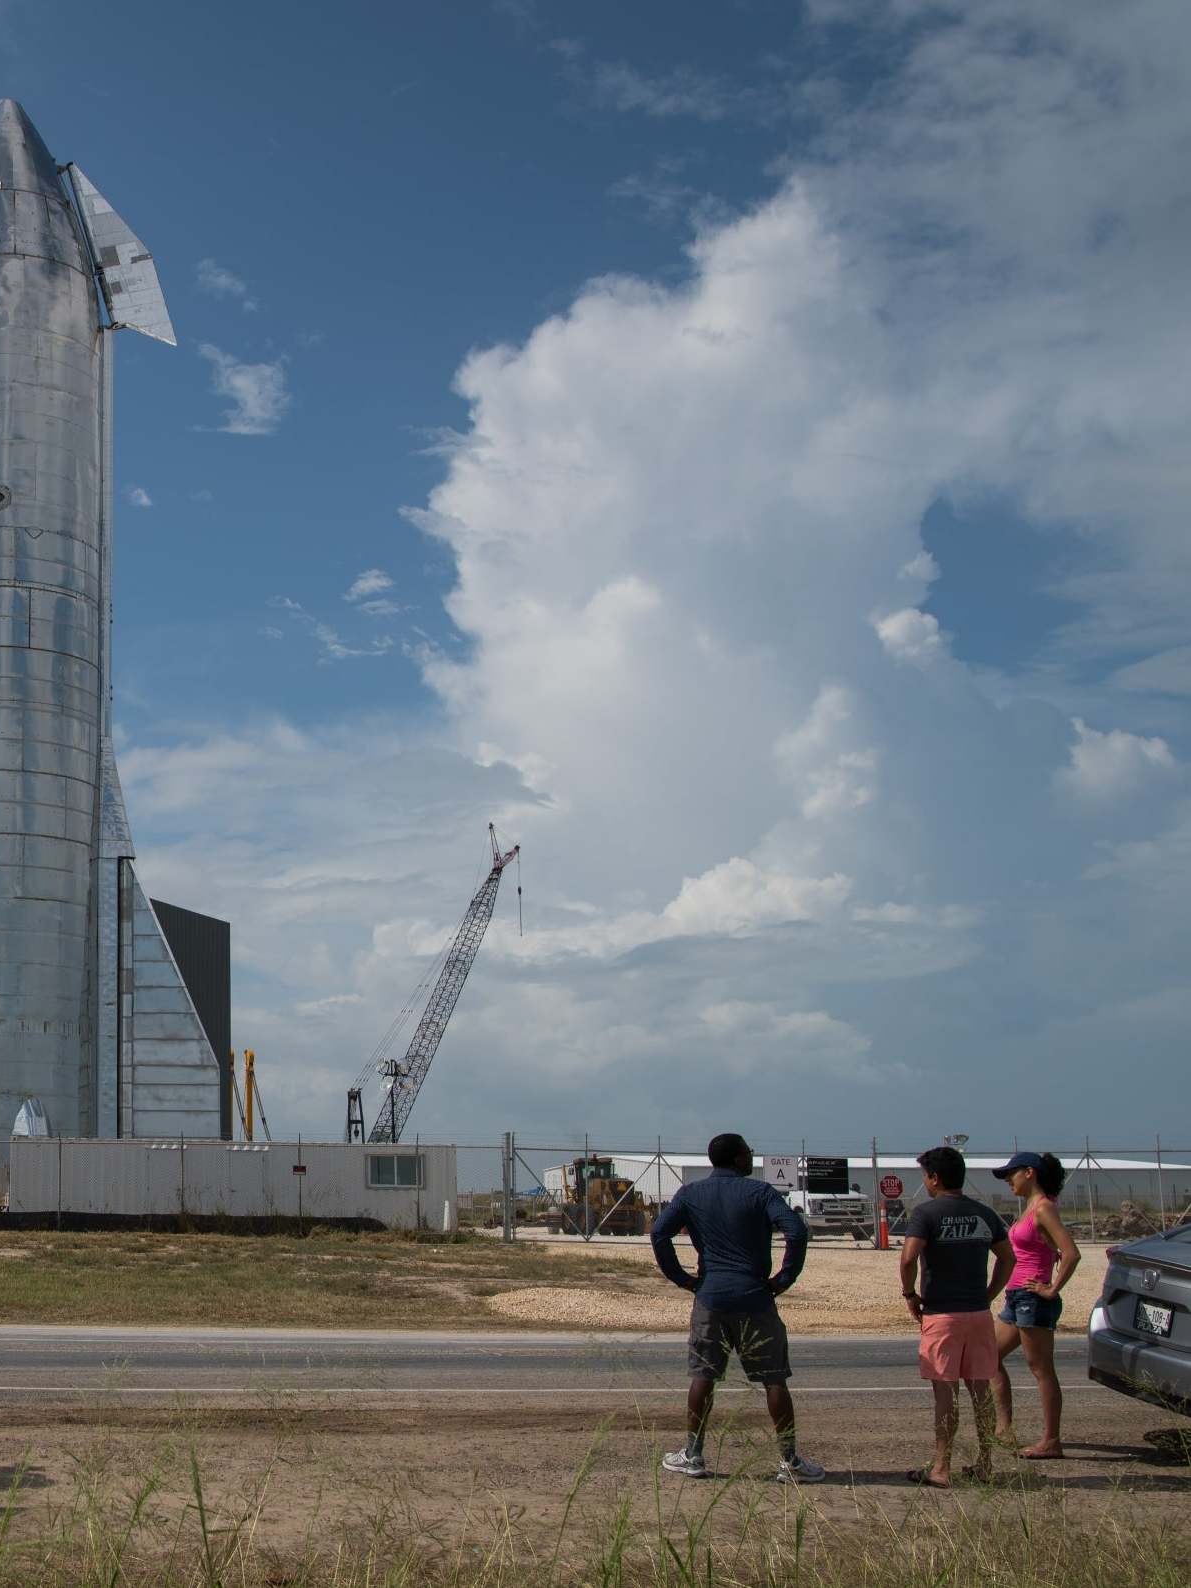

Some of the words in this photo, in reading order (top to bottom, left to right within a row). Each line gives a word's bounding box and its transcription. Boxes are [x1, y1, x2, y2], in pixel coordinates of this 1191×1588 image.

[771, 1158, 792, 1166] GATE
[777, 1168, 785, 1180] A
[882, 1179, 900, 1188] STOP
[941, 1215, 977, 1225] CHASING
[939, 1225, 972, 1239] TAIL
